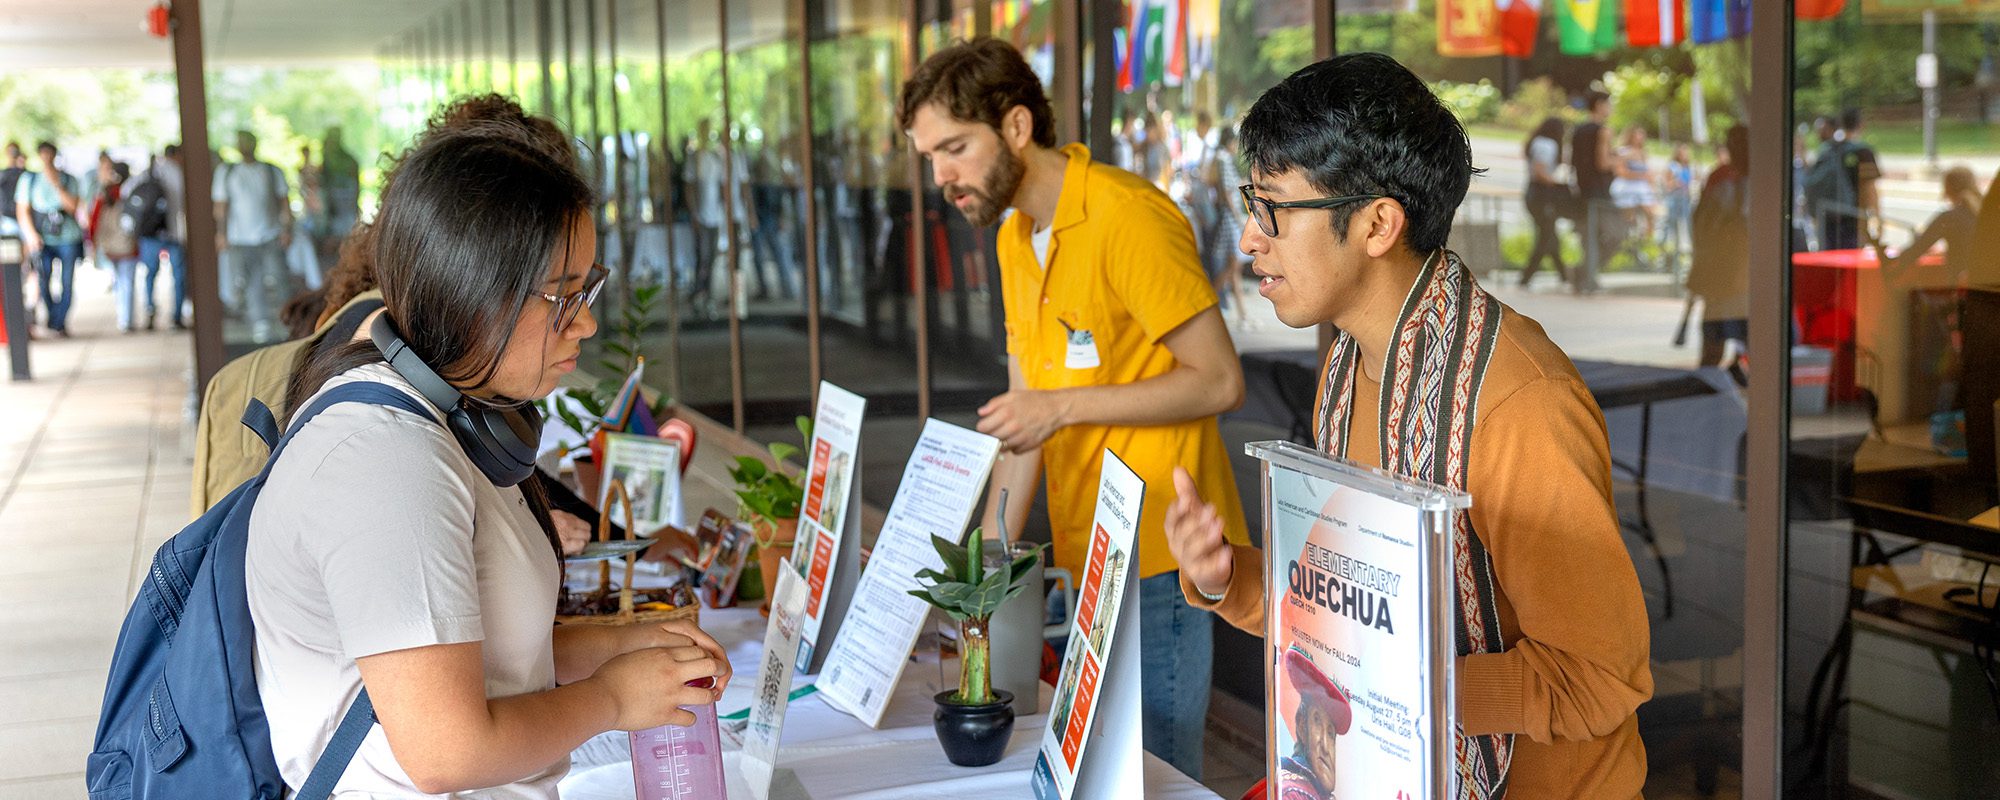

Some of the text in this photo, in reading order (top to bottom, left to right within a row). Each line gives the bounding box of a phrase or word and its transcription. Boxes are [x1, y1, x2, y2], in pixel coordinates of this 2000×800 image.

[1305, 542, 1401, 598] ELEMENTARY
[1288, 560, 1394, 635] QUECHUA
[1291, 625, 1311, 643] REGISTER
[1312, 637, 1324, 651] NOW
[1333, 648, 1346, 662] FALL
[1347, 654, 1361, 668] 2024
[1402, 718, 1411, 726] pm
